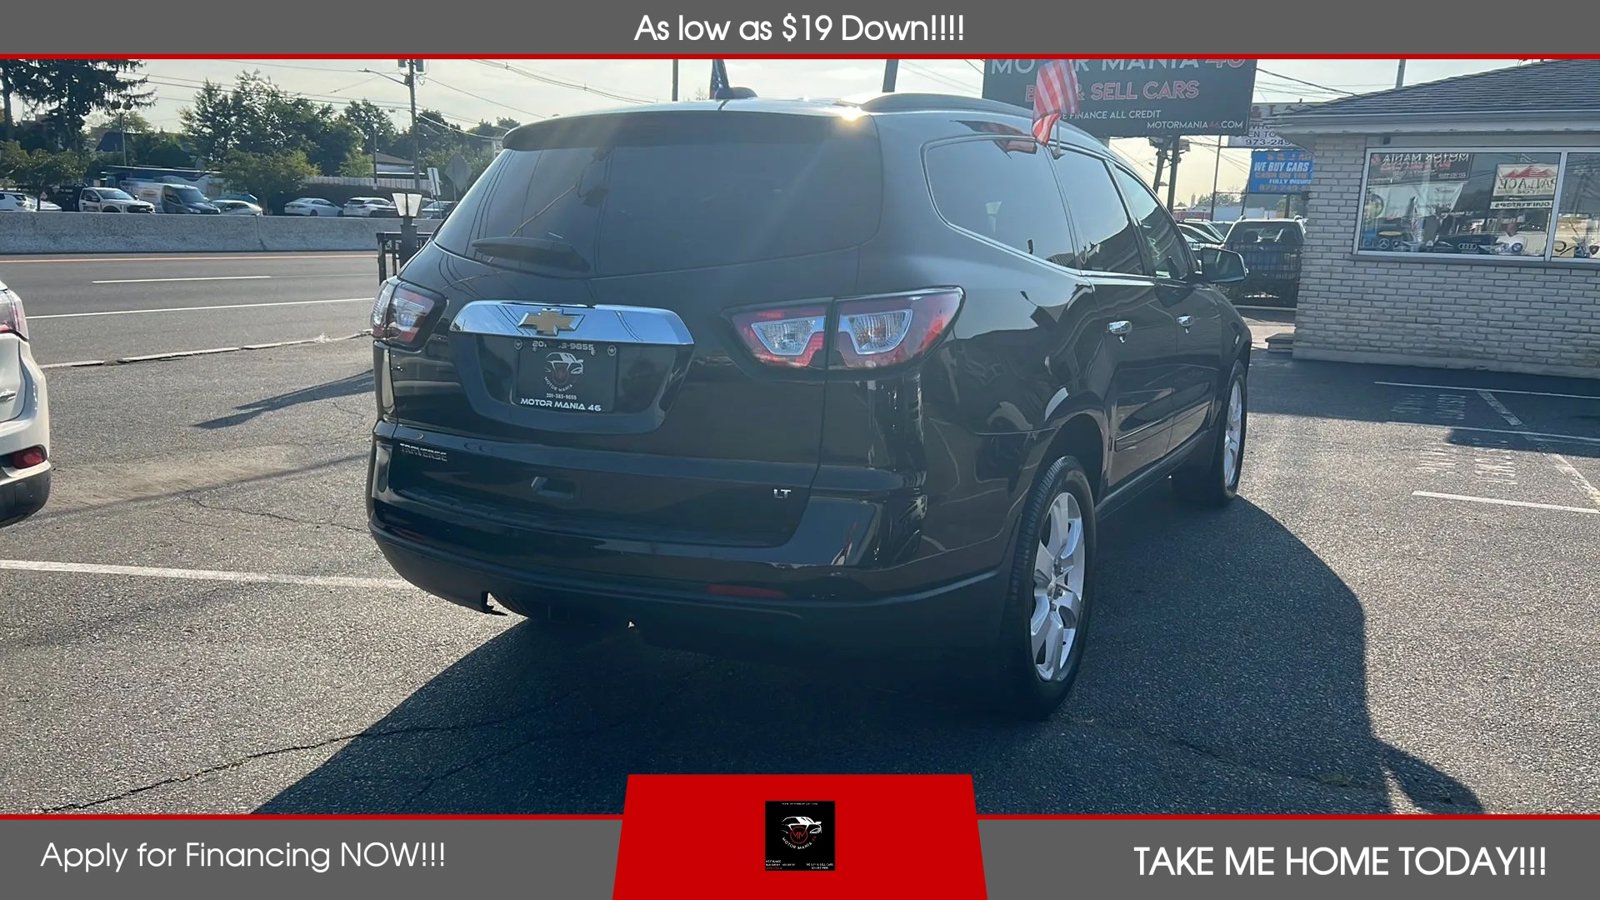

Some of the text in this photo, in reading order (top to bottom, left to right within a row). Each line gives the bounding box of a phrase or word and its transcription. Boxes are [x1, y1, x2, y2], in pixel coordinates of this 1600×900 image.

[991, 59, 1090, 74] MOR
[1090, 82, 1138, 100] SELL
[1142, 80, 1200, 99] CARS
[1109, 110, 1127, 119] ALL
[1128, 109, 1162, 119] CREDIT
[1268, 161, 1286, 172] BUY
[520, 398, 553, 407] MOTOR
[554, 401, 586, 411] MANIA
[773, 488, 792, 499] LT
